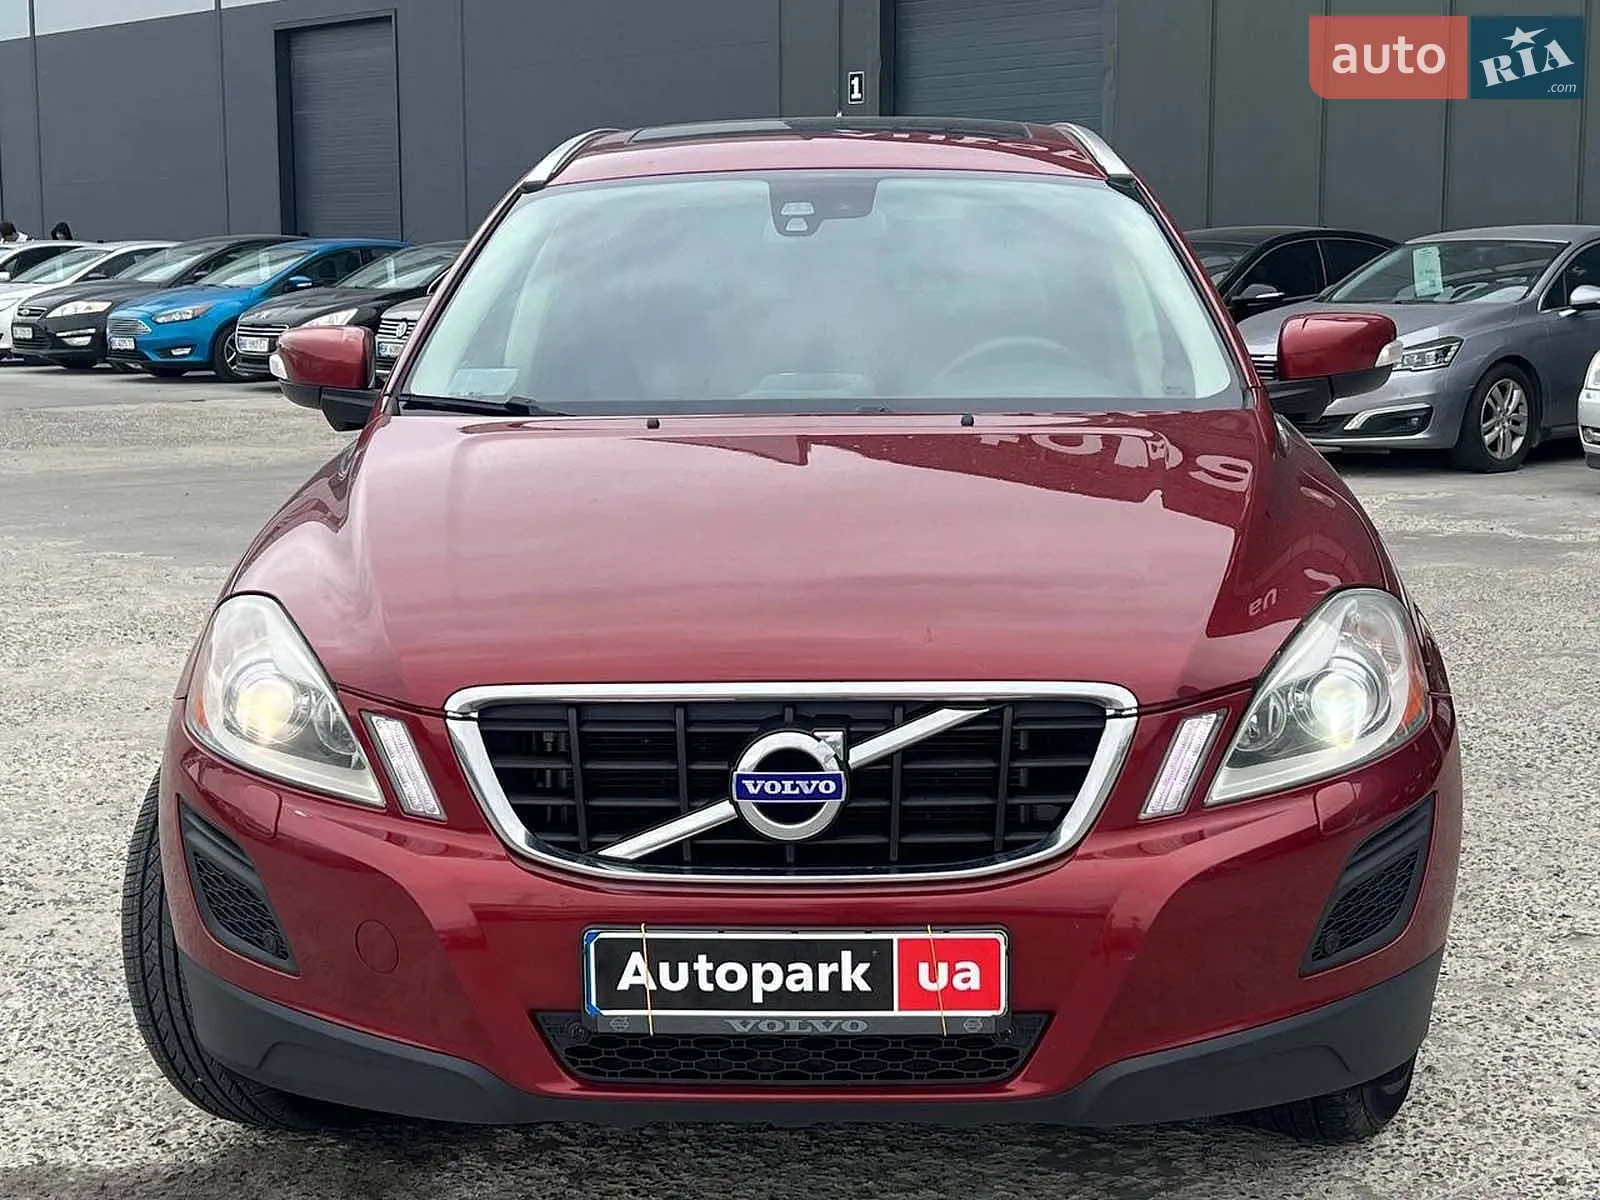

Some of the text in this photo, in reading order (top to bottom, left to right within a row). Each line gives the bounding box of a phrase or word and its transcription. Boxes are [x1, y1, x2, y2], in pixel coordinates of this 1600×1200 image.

[851, 77, 862, 99] 1
[742, 780, 836, 795] VOLVO
[616, 950, 981, 1003] Autopark ua
[725, 1018, 870, 1033] VOLVO
